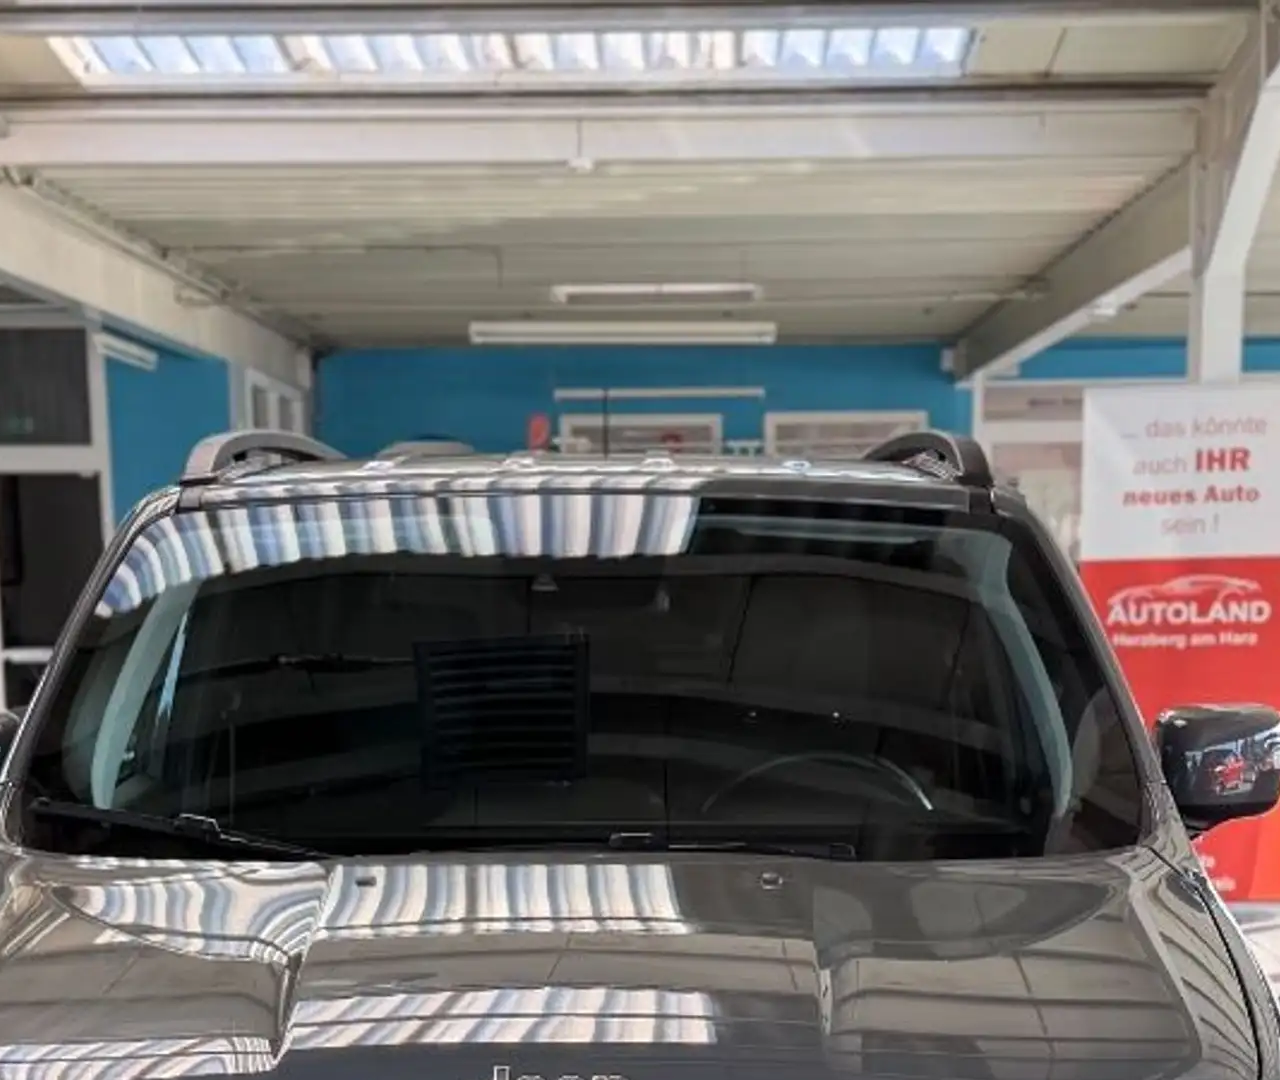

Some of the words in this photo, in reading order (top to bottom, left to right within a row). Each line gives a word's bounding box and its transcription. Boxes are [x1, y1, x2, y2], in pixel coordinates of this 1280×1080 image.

[1145, 418, 1186, 438] das
[1192, 416, 1268, 437] könnte
[1132, 454, 1187, 475] auch
[1195, 447, 1251, 472] IHR
[1122, 489, 1197, 507] neues
[1204, 485, 1261, 503] Auto
[1161, 514, 1206, 535] sein
[1106, 600, 1272, 626] AUTOLAND
